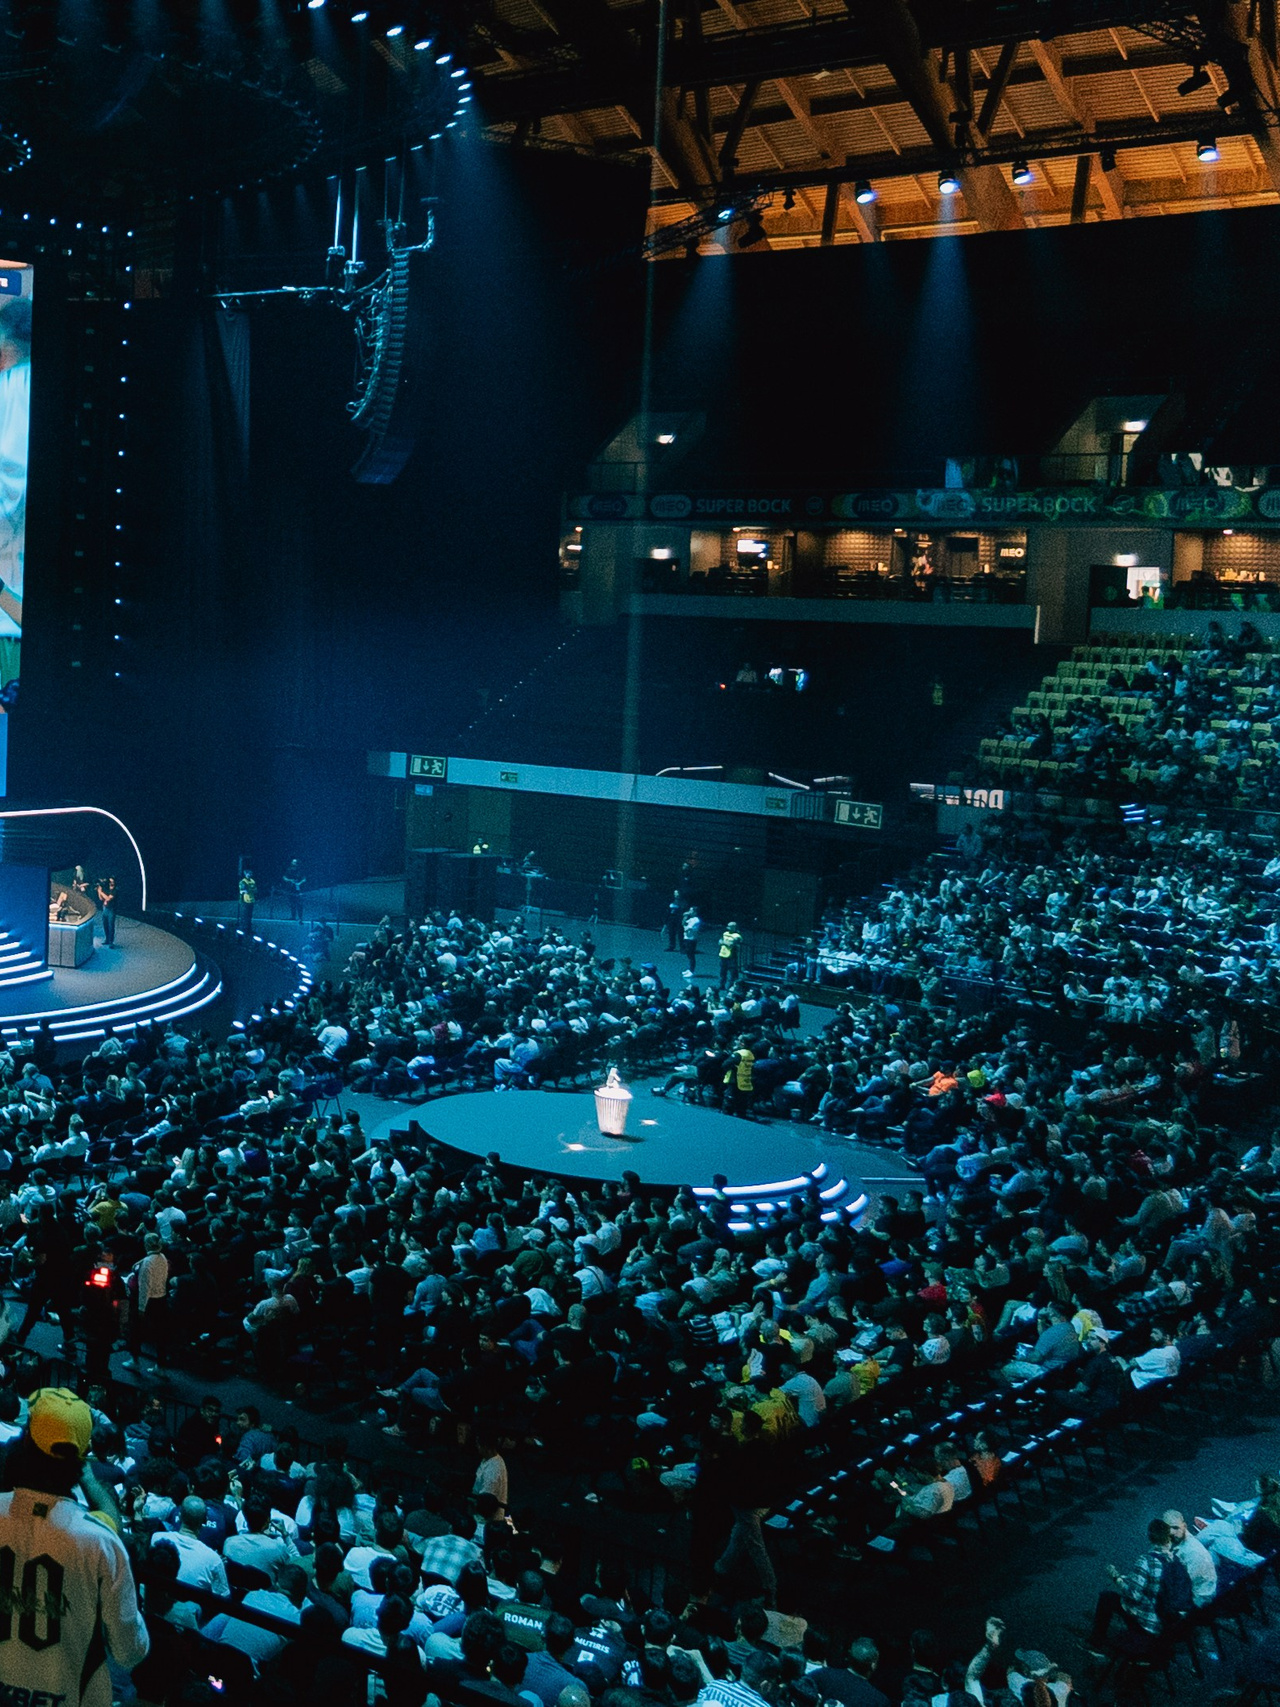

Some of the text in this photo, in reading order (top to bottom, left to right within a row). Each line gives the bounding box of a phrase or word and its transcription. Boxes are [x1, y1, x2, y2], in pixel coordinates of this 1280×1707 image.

[696, 498, 745, 513] SUPER
[748, 498, 792, 513] BOCK
[981, 497, 1097, 513] SUPER BOCK
[1000, 547, 1025, 558] MEO
[504, 1612, 543, 1631] ROMAN
